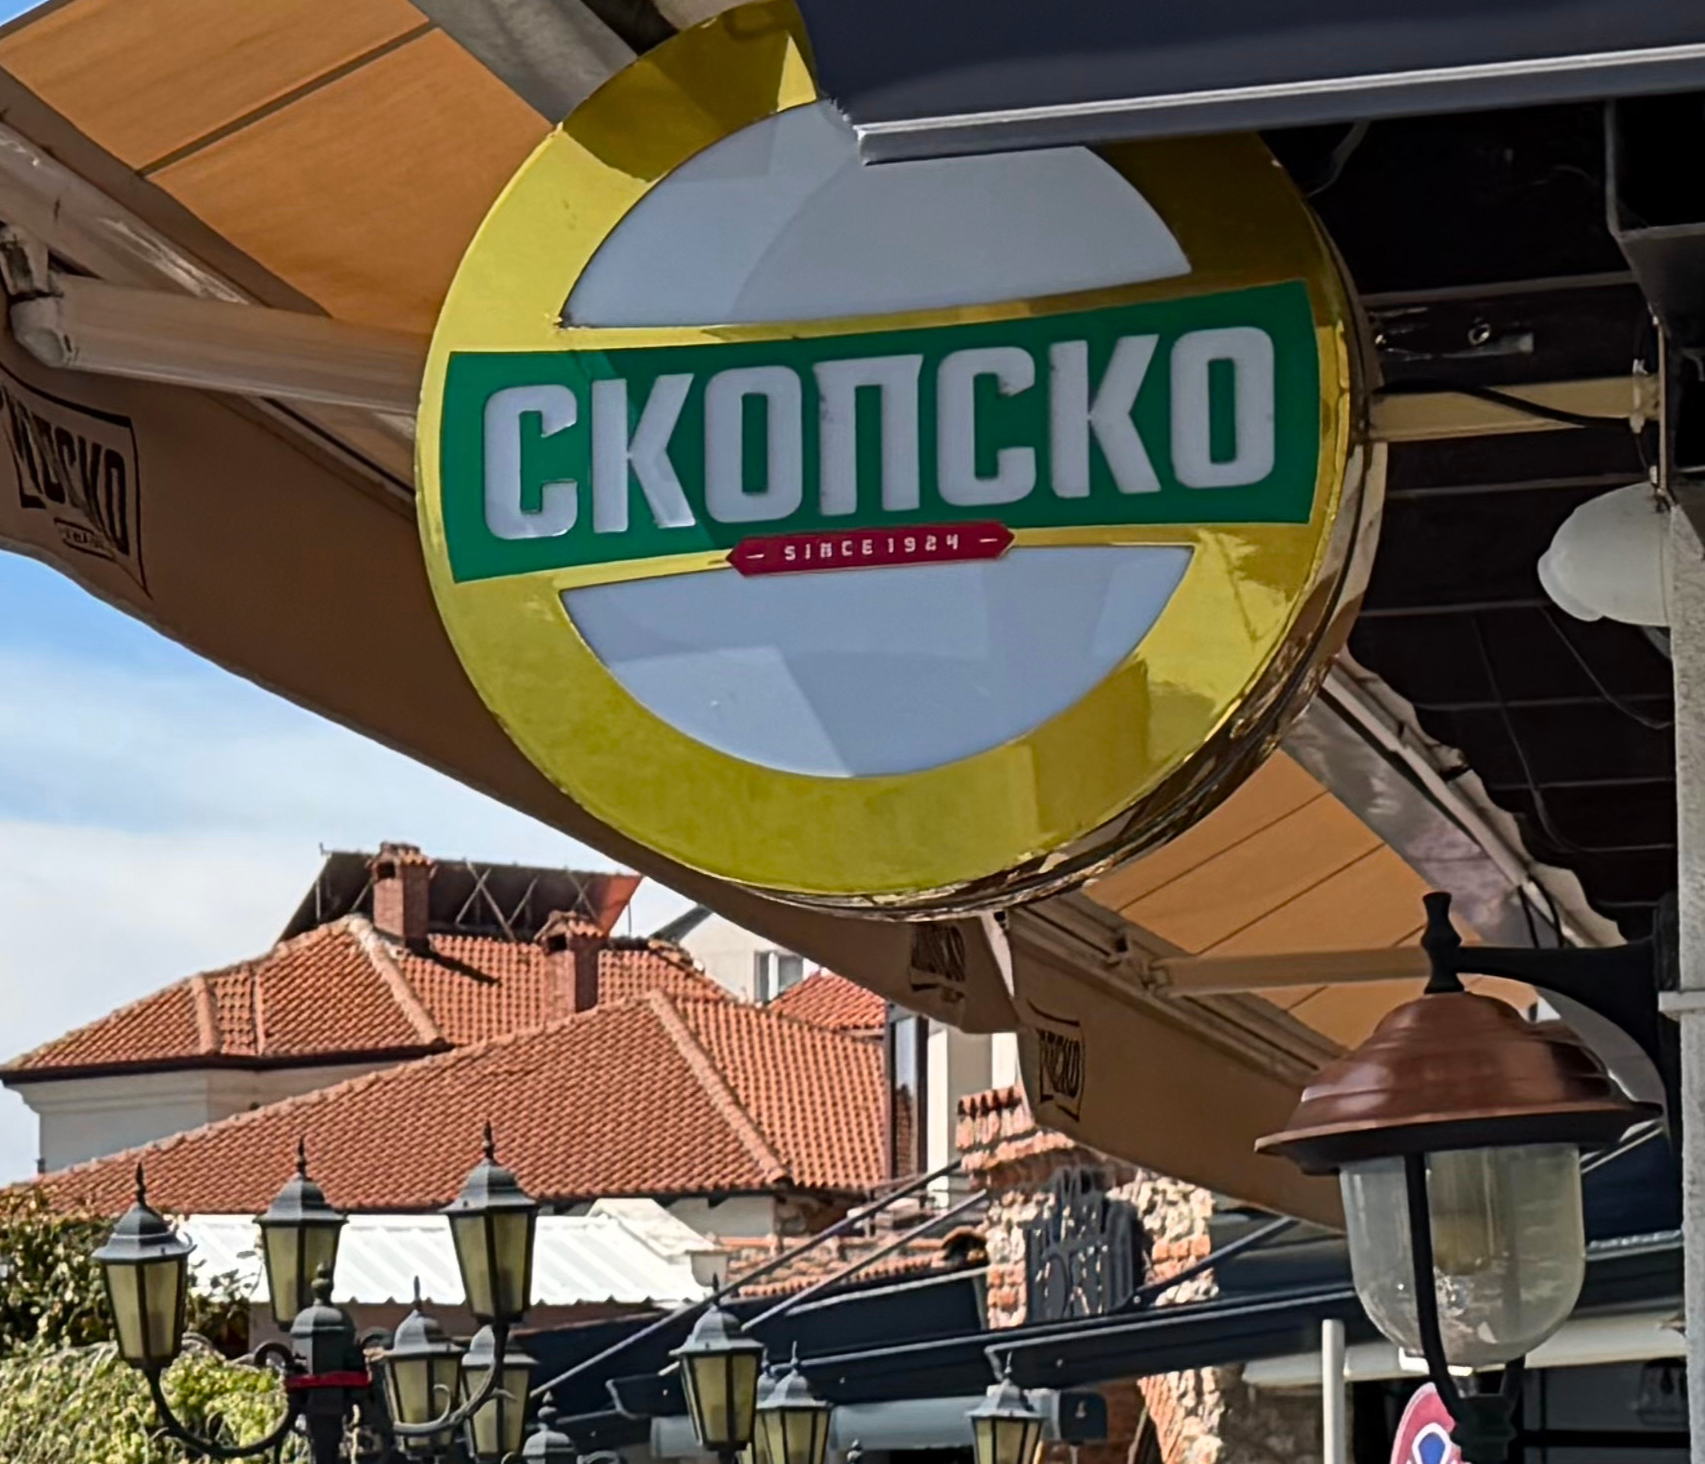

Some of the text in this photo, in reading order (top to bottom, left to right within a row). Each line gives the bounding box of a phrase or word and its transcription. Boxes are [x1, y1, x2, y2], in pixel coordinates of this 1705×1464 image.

[483, 325, 1276, 542] СКОПСКО
[783, 533, 959, 561] SINCE 1924
